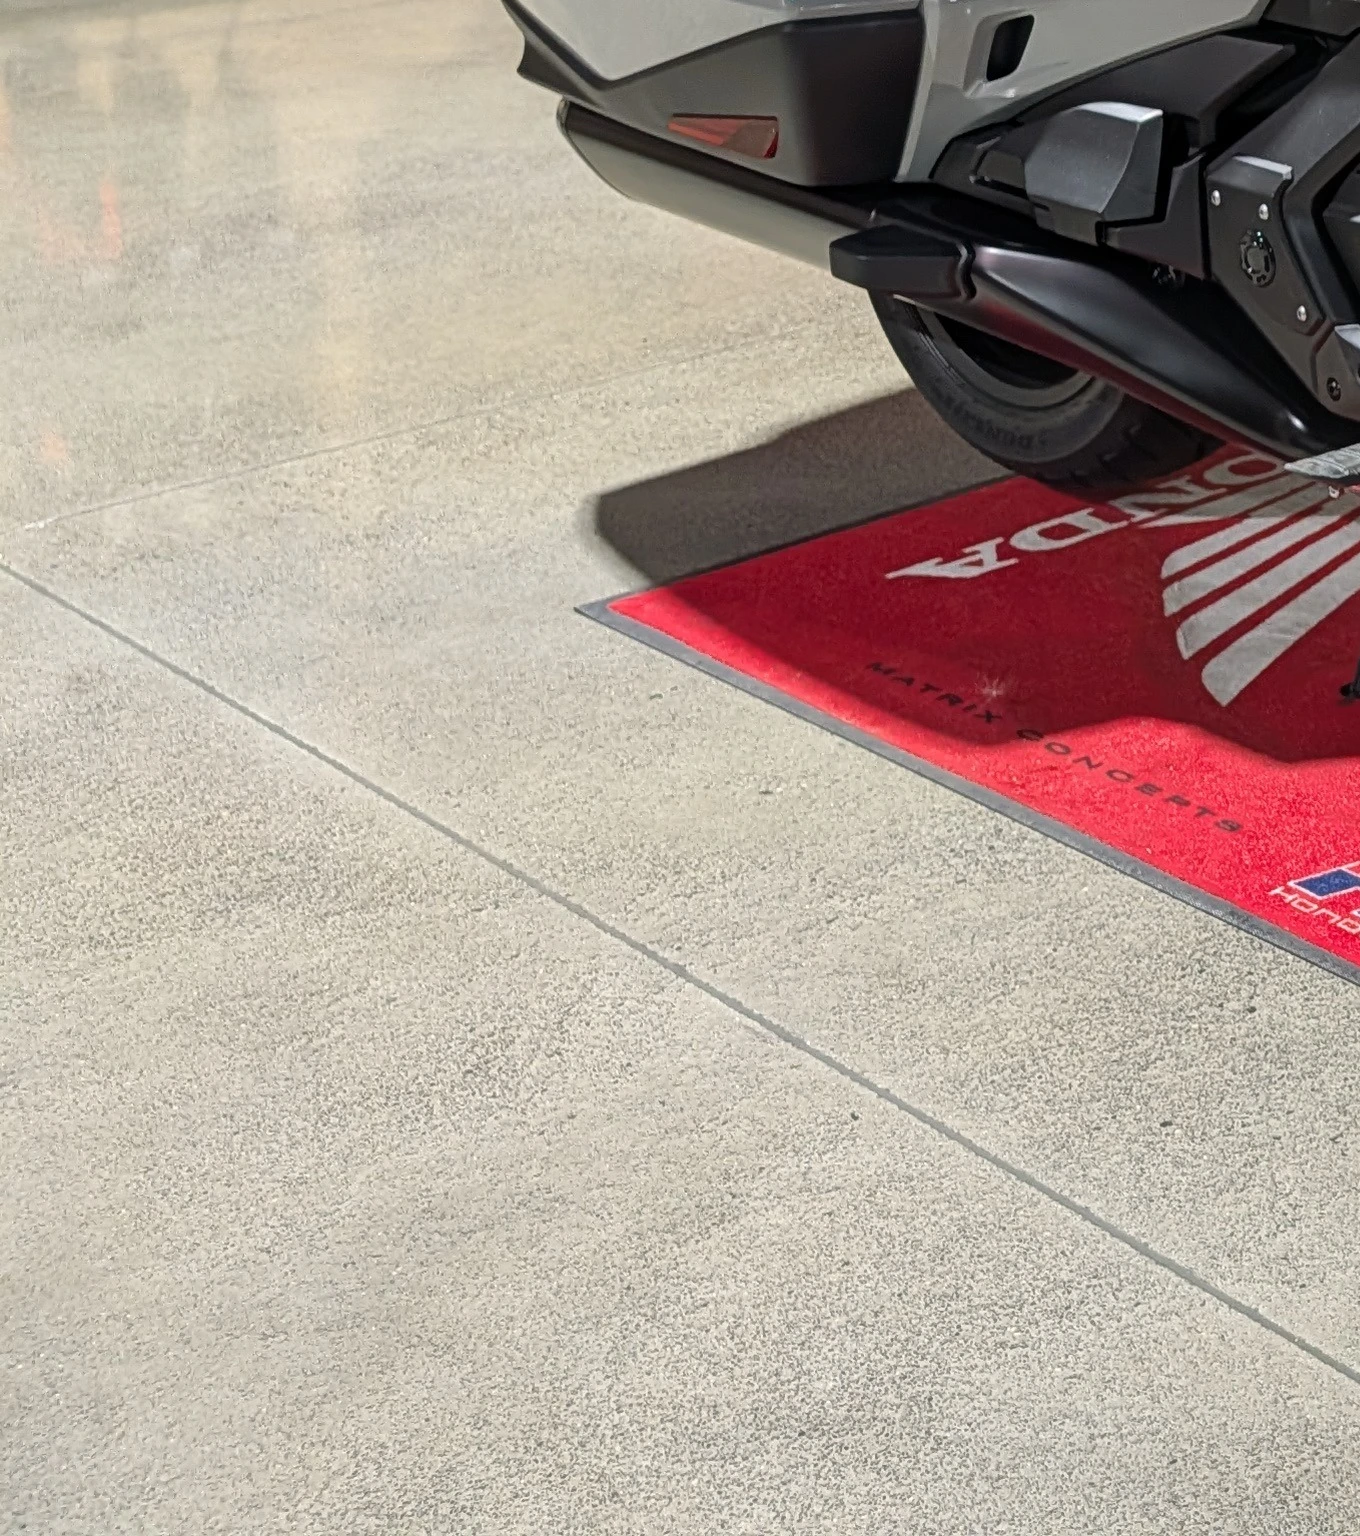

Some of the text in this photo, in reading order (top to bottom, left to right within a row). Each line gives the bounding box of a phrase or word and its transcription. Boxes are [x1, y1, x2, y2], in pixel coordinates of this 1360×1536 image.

[884, 450, 1287, 580] ONDA
[869, 663, 1242, 833] MATRIX CONCEPTS
